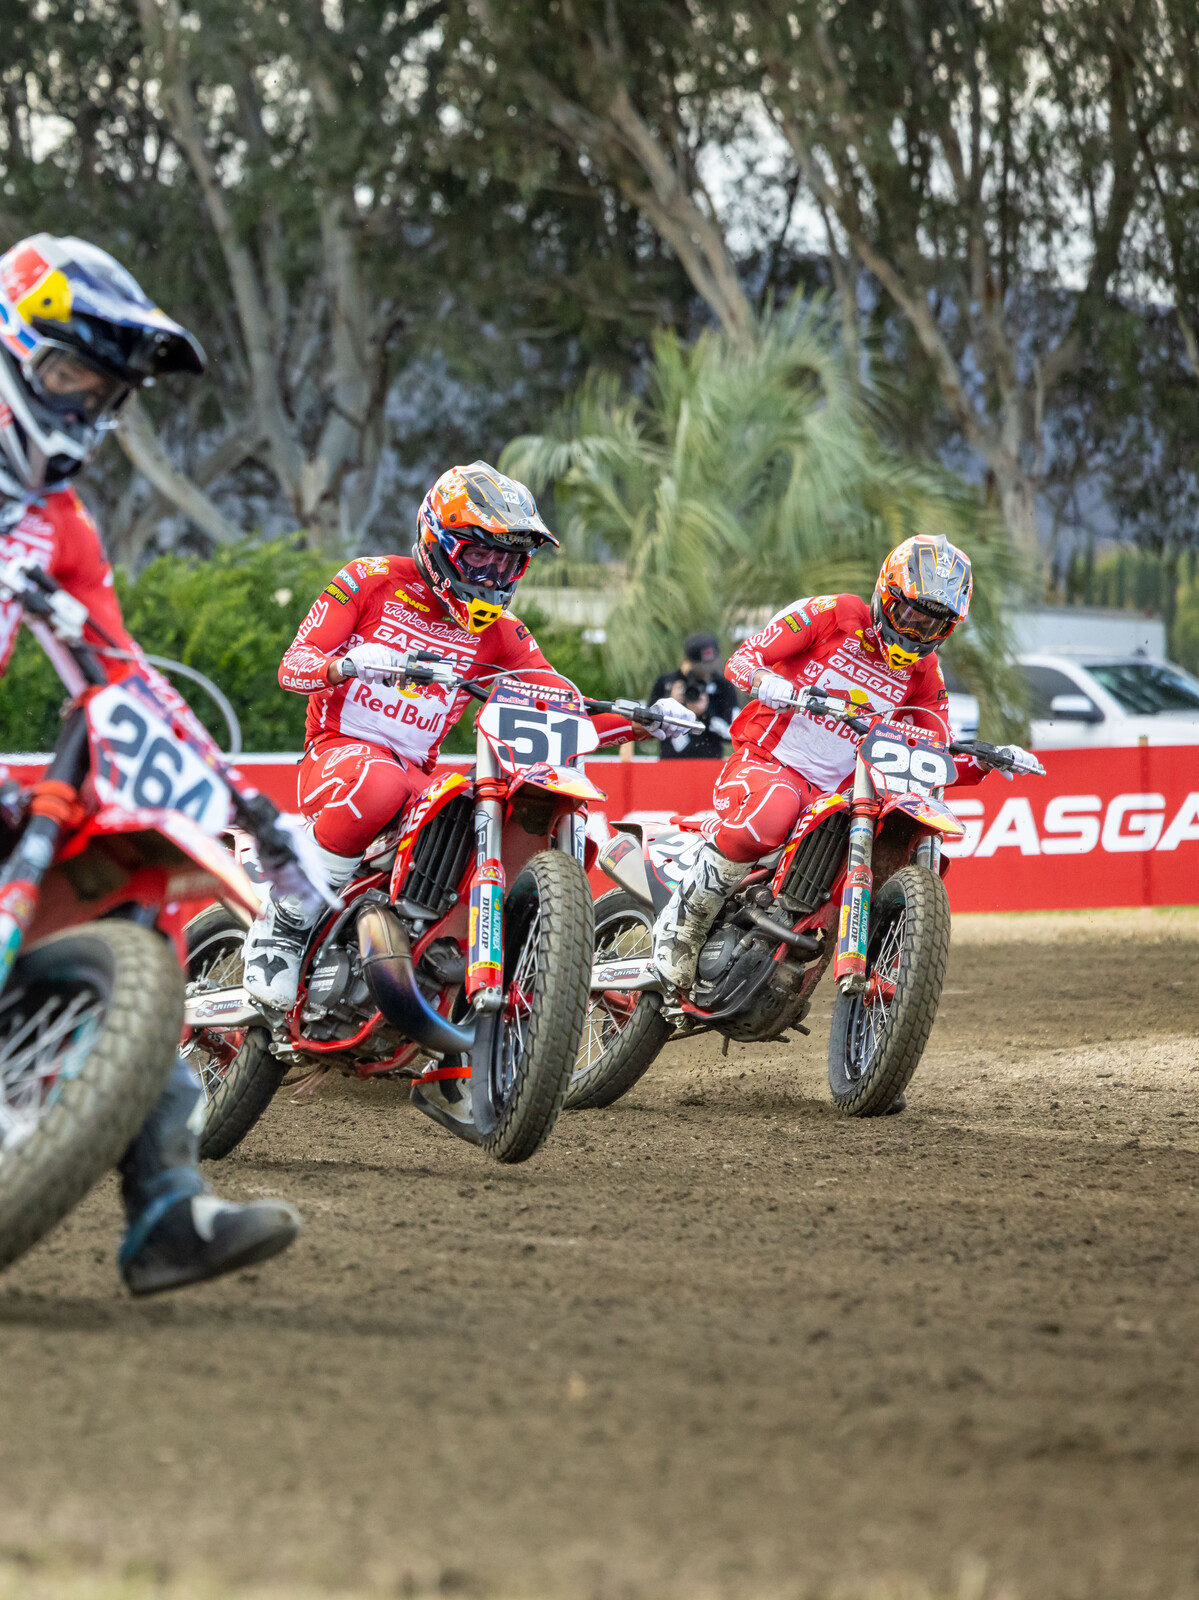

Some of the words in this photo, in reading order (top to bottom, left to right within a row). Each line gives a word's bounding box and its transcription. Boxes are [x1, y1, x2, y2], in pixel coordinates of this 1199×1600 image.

[384, 601, 409, 623] Troy
[409, 611, 429, 631] Lee
[282, 675, 326, 690] GASGAS
[828, 654, 905, 703] GASGAS
[353, 683, 403, 719] Red
[401, 704, 443, 733] Bull
[498, 706, 579, 767] 51
[837, 722, 859, 745] Bu
[870, 740, 948, 797] 29
[481, 896, 491, 950] DUNLOP
[493, 909, 501, 951] MOTOREX
[850, 897, 861, 944] DUNLOP
